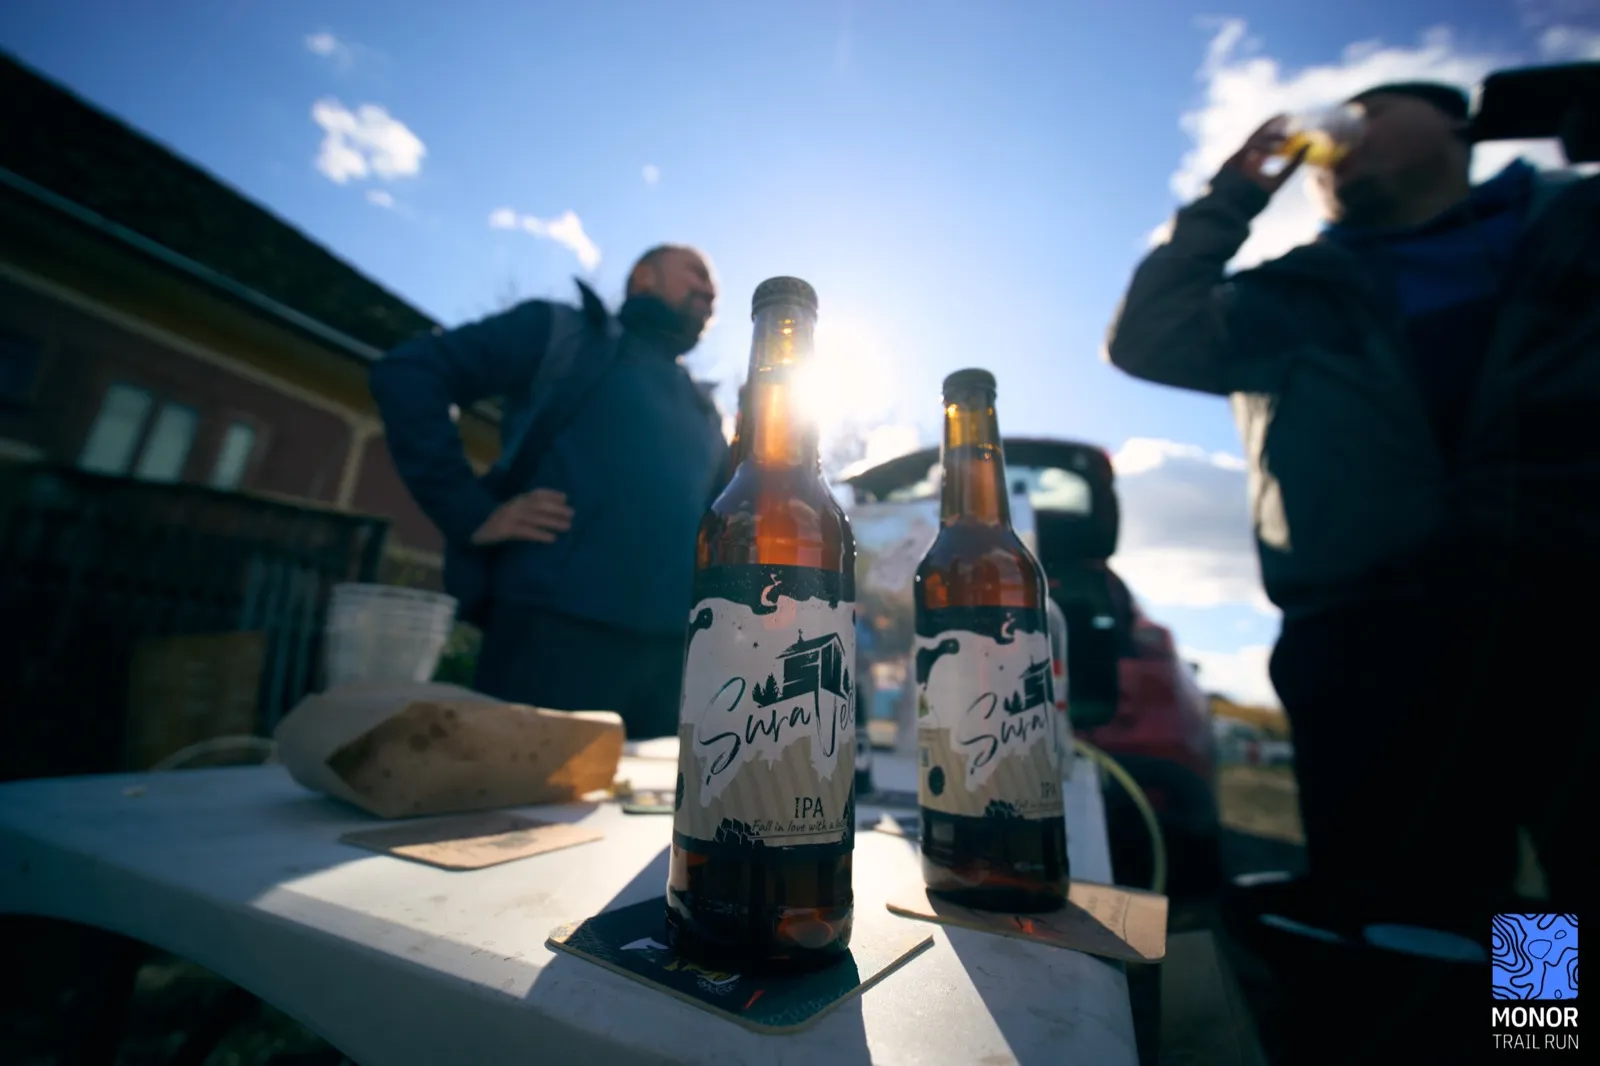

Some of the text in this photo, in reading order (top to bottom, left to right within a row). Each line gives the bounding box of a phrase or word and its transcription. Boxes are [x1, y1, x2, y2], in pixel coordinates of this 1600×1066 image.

[794, 796, 824, 819] IPA
[751, 819, 773, 832] Fall
[774, 822, 784, 832] in
[788, 820, 806, 832] love
[808, 819, 827, 831] with
